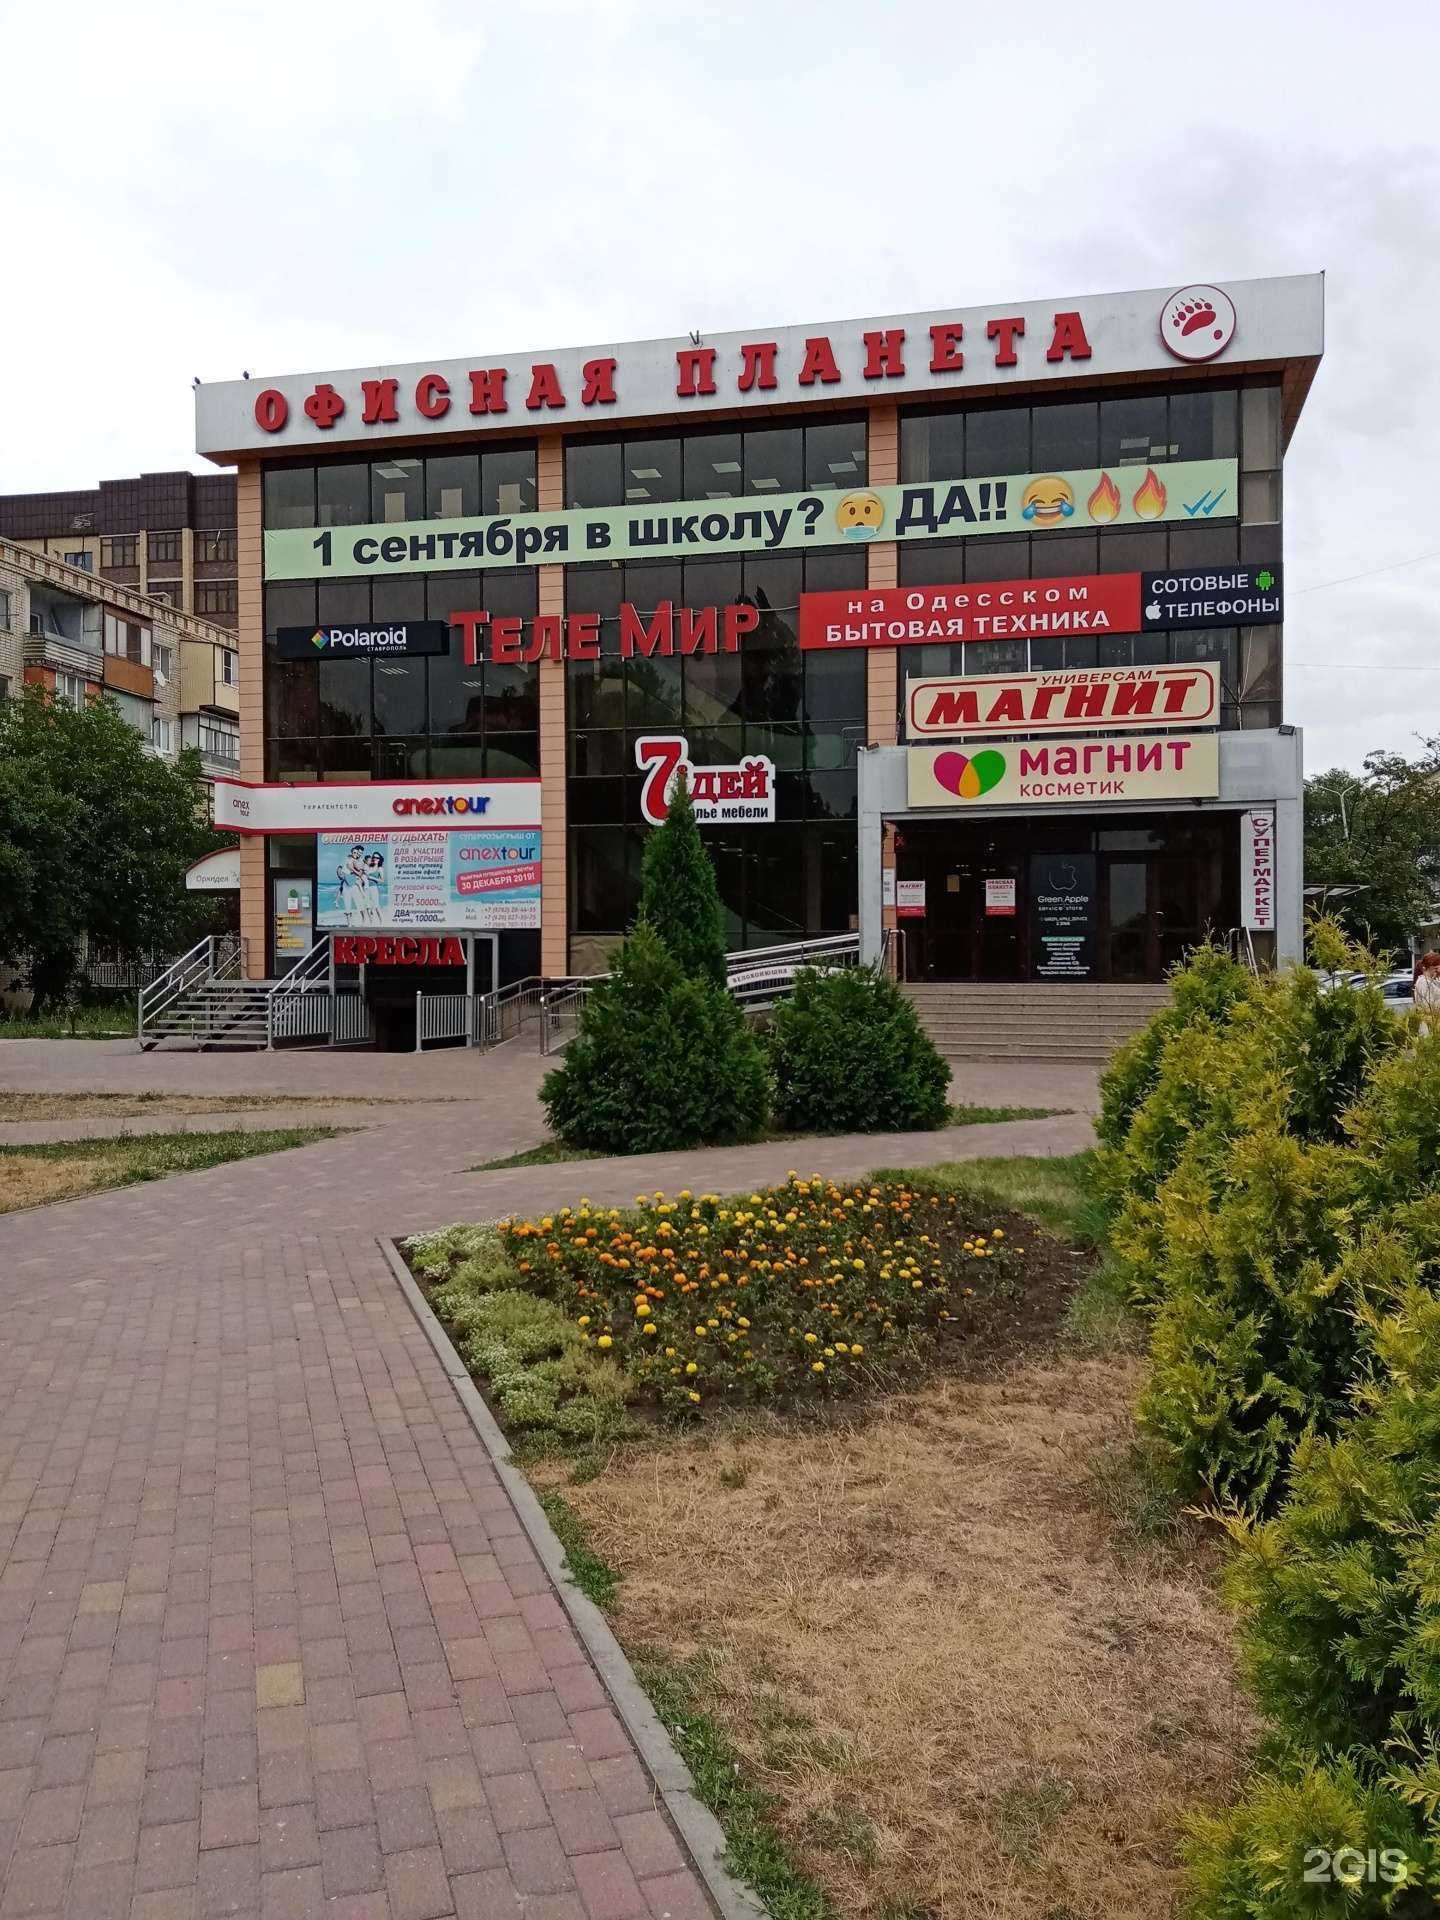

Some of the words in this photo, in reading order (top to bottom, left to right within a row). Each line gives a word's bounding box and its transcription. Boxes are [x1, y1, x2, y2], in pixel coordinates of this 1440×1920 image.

[254, 357, 617, 432] ОФИСНАЯ
[676, 312, 1092, 396] ПЛАНЕТА
[313, 532, 333, 567] 1
[353, 518, 569, 565] сентября
[586, 521, 611, 550] в
[630, 499, 825, 548] школу?
[896, 481, 1008, 535] ДА!!
[1151, 573, 1249, 594] СОТОВЫЕ
[847, 597, 885, 614] на
[906, 583, 1089, 614] Одесском
[1165, 597, 1280, 619] ТЕЛЕФОНЫ
[825, 617, 964, 642] БЫТОВАЯ
[973, 609, 1111, 636] ТЕХНИКА
[330, 627, 407, 647] Polaroid
[1040, 669, 1154, 687] УНИВЕРСАМ
[924, 678, 1199, 725] МАГНИТ
[1019, 779, 1125, 797] косметик
[232, 799, 250, 810] anex
[392, 796, 491, 816] anextour
[721, 805, 769, 818] мебели
[459, 846, 536, 860] anextour
[1253, 817, 1272, 926] СУПЕРМАРКЕТ
[473, 876, 512, 890] ДЕКАБРЯ
[1037, 895, 1063, 903] Green
[1065, 895, 1089, 903] Apple
[333, 936, 468, 965] КРЕСЛА
